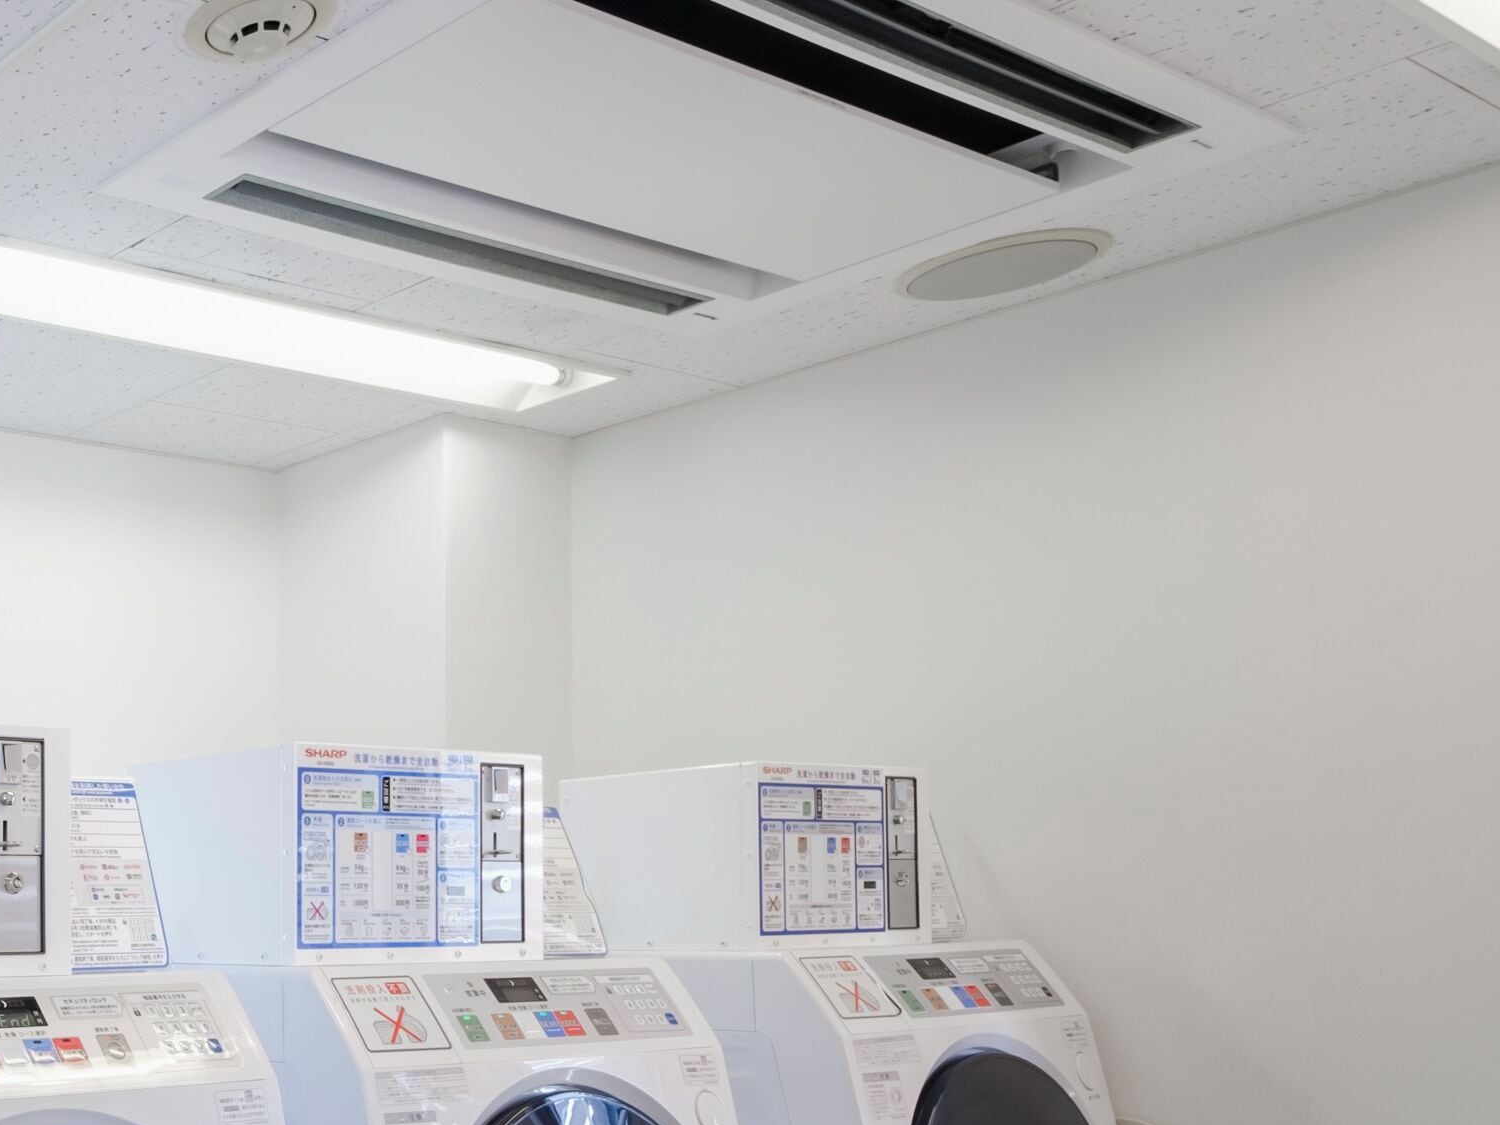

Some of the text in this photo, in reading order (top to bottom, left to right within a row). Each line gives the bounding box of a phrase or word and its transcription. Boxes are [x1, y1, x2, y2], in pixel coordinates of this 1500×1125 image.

[305, 748, 347, 759] SHARP
[762, 767, 792, 775] SHARP
[0, 1014, 31, 1027] End
